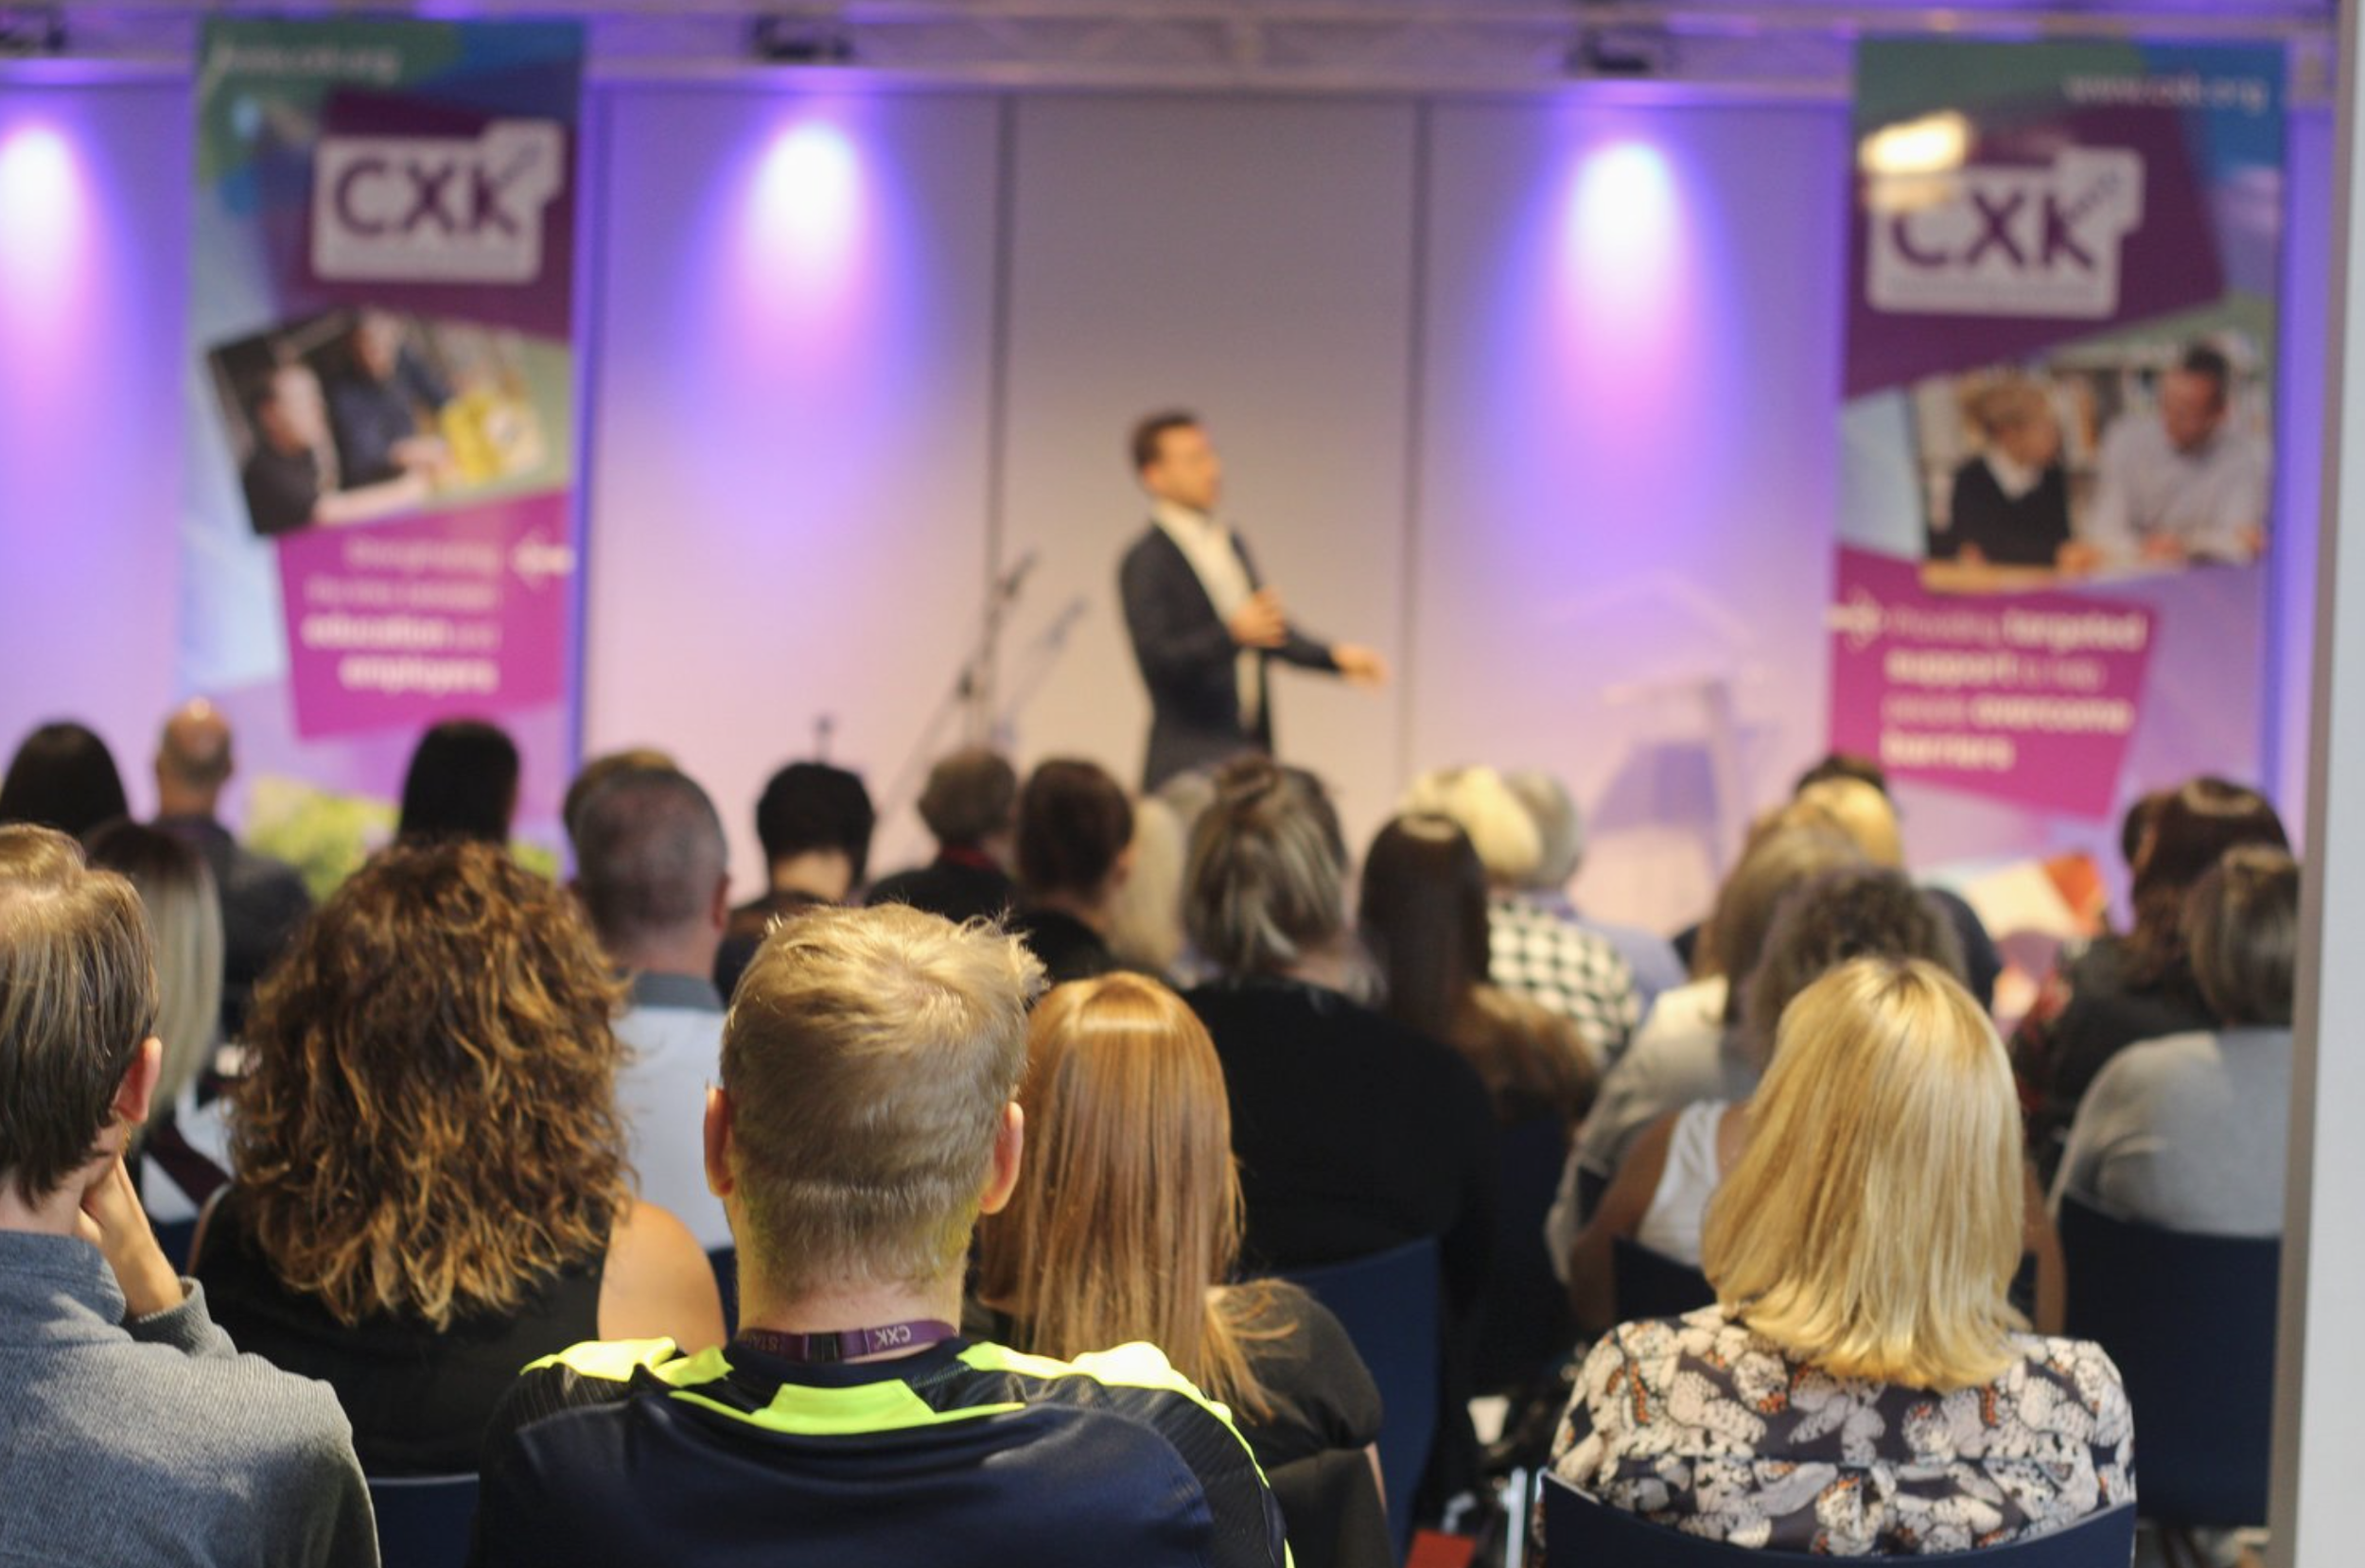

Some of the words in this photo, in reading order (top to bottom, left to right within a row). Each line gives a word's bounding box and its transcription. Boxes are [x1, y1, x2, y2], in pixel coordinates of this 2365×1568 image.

[335, 156, 519, 236] CXK
[1893, 191, 2096, 269] CXK
[875, 1325, 911, 1350] CXK
